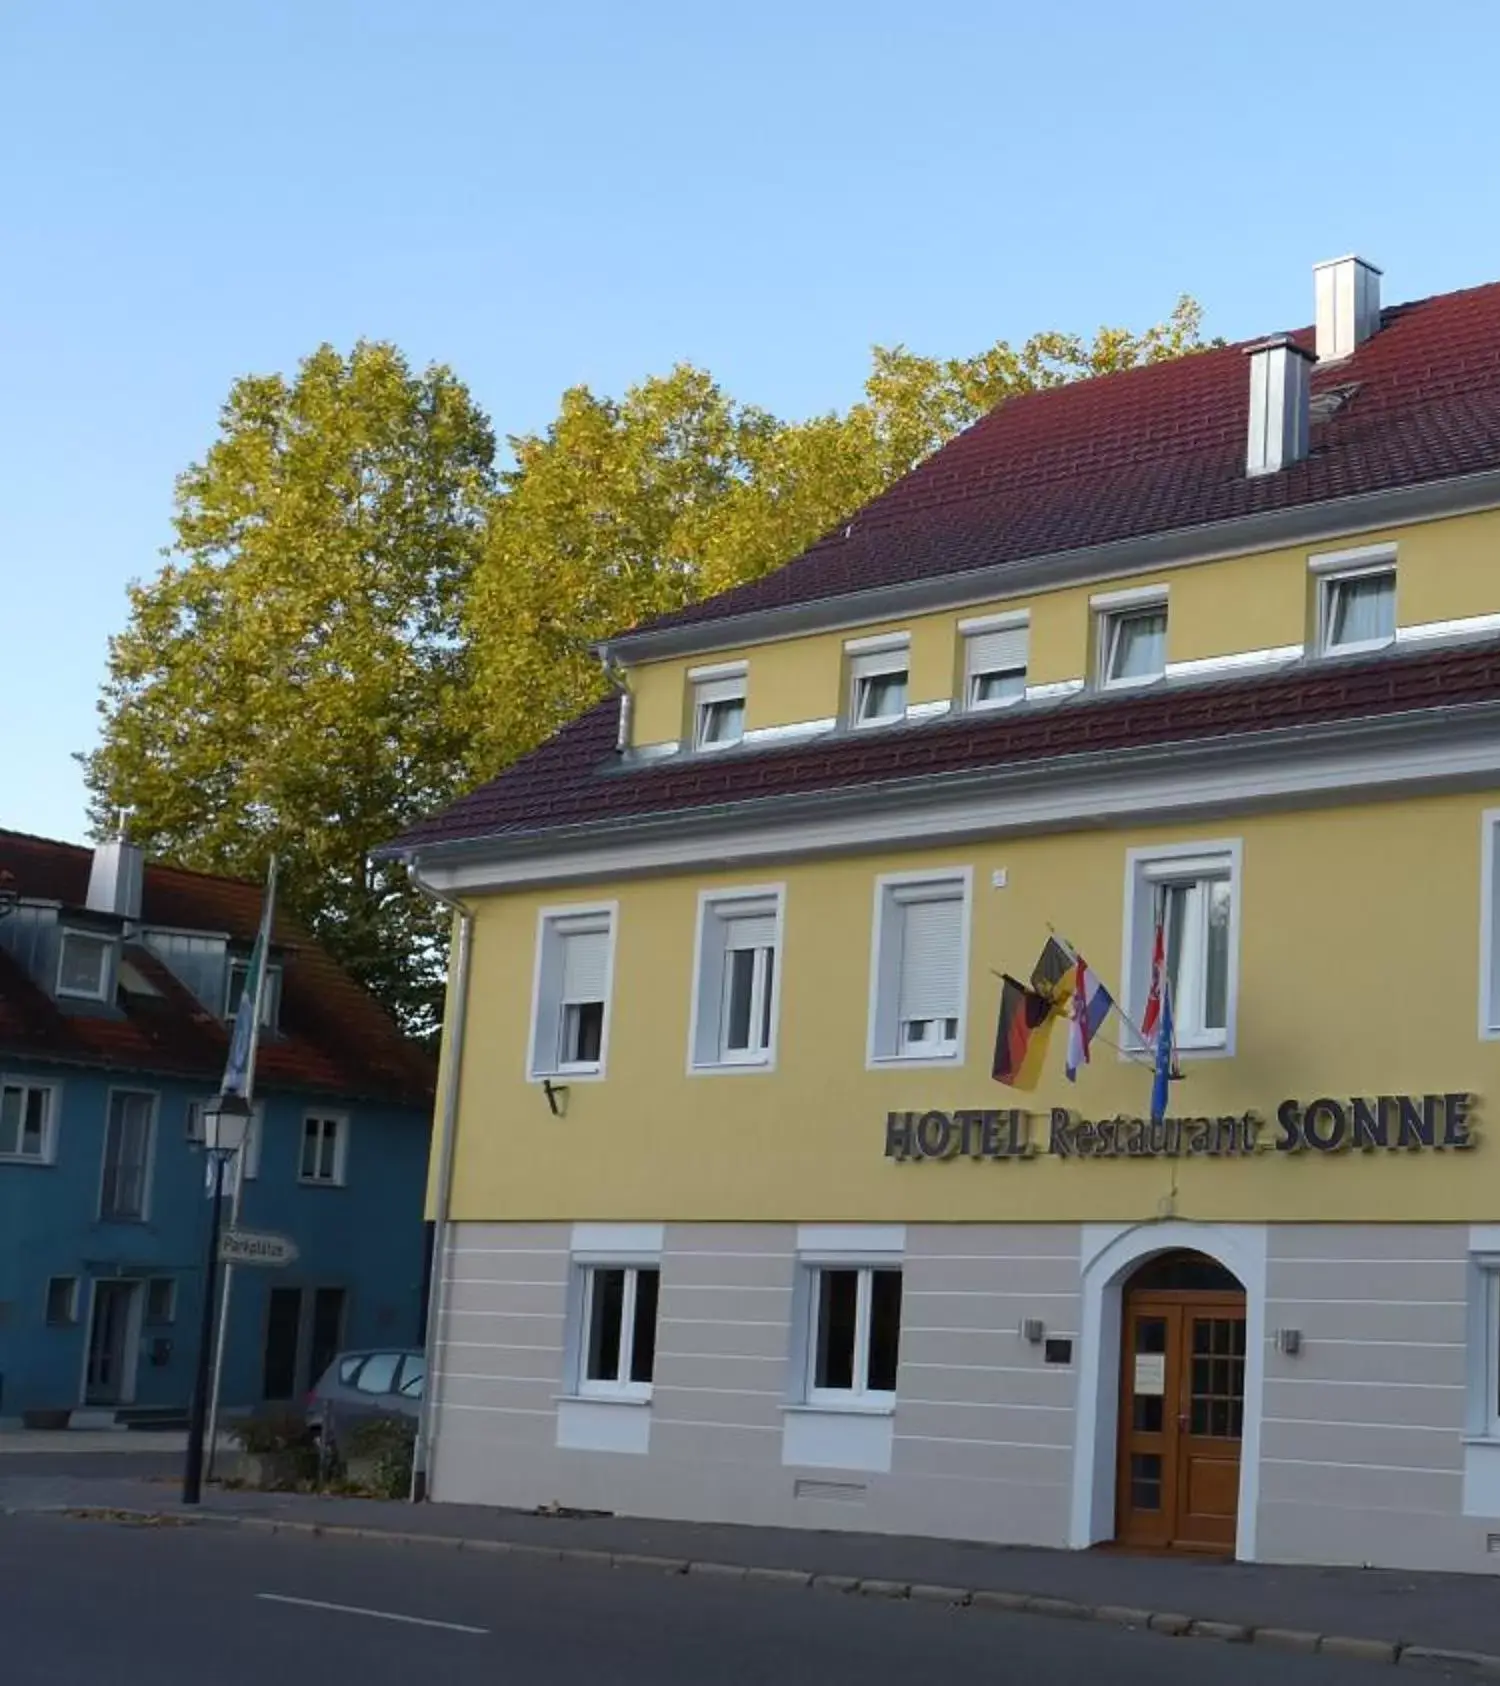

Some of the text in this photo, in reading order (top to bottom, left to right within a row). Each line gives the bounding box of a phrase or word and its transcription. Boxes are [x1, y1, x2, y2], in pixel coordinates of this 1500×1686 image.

[884, 1093, 1473, 1157] HOTEL Restaurant SONNE
